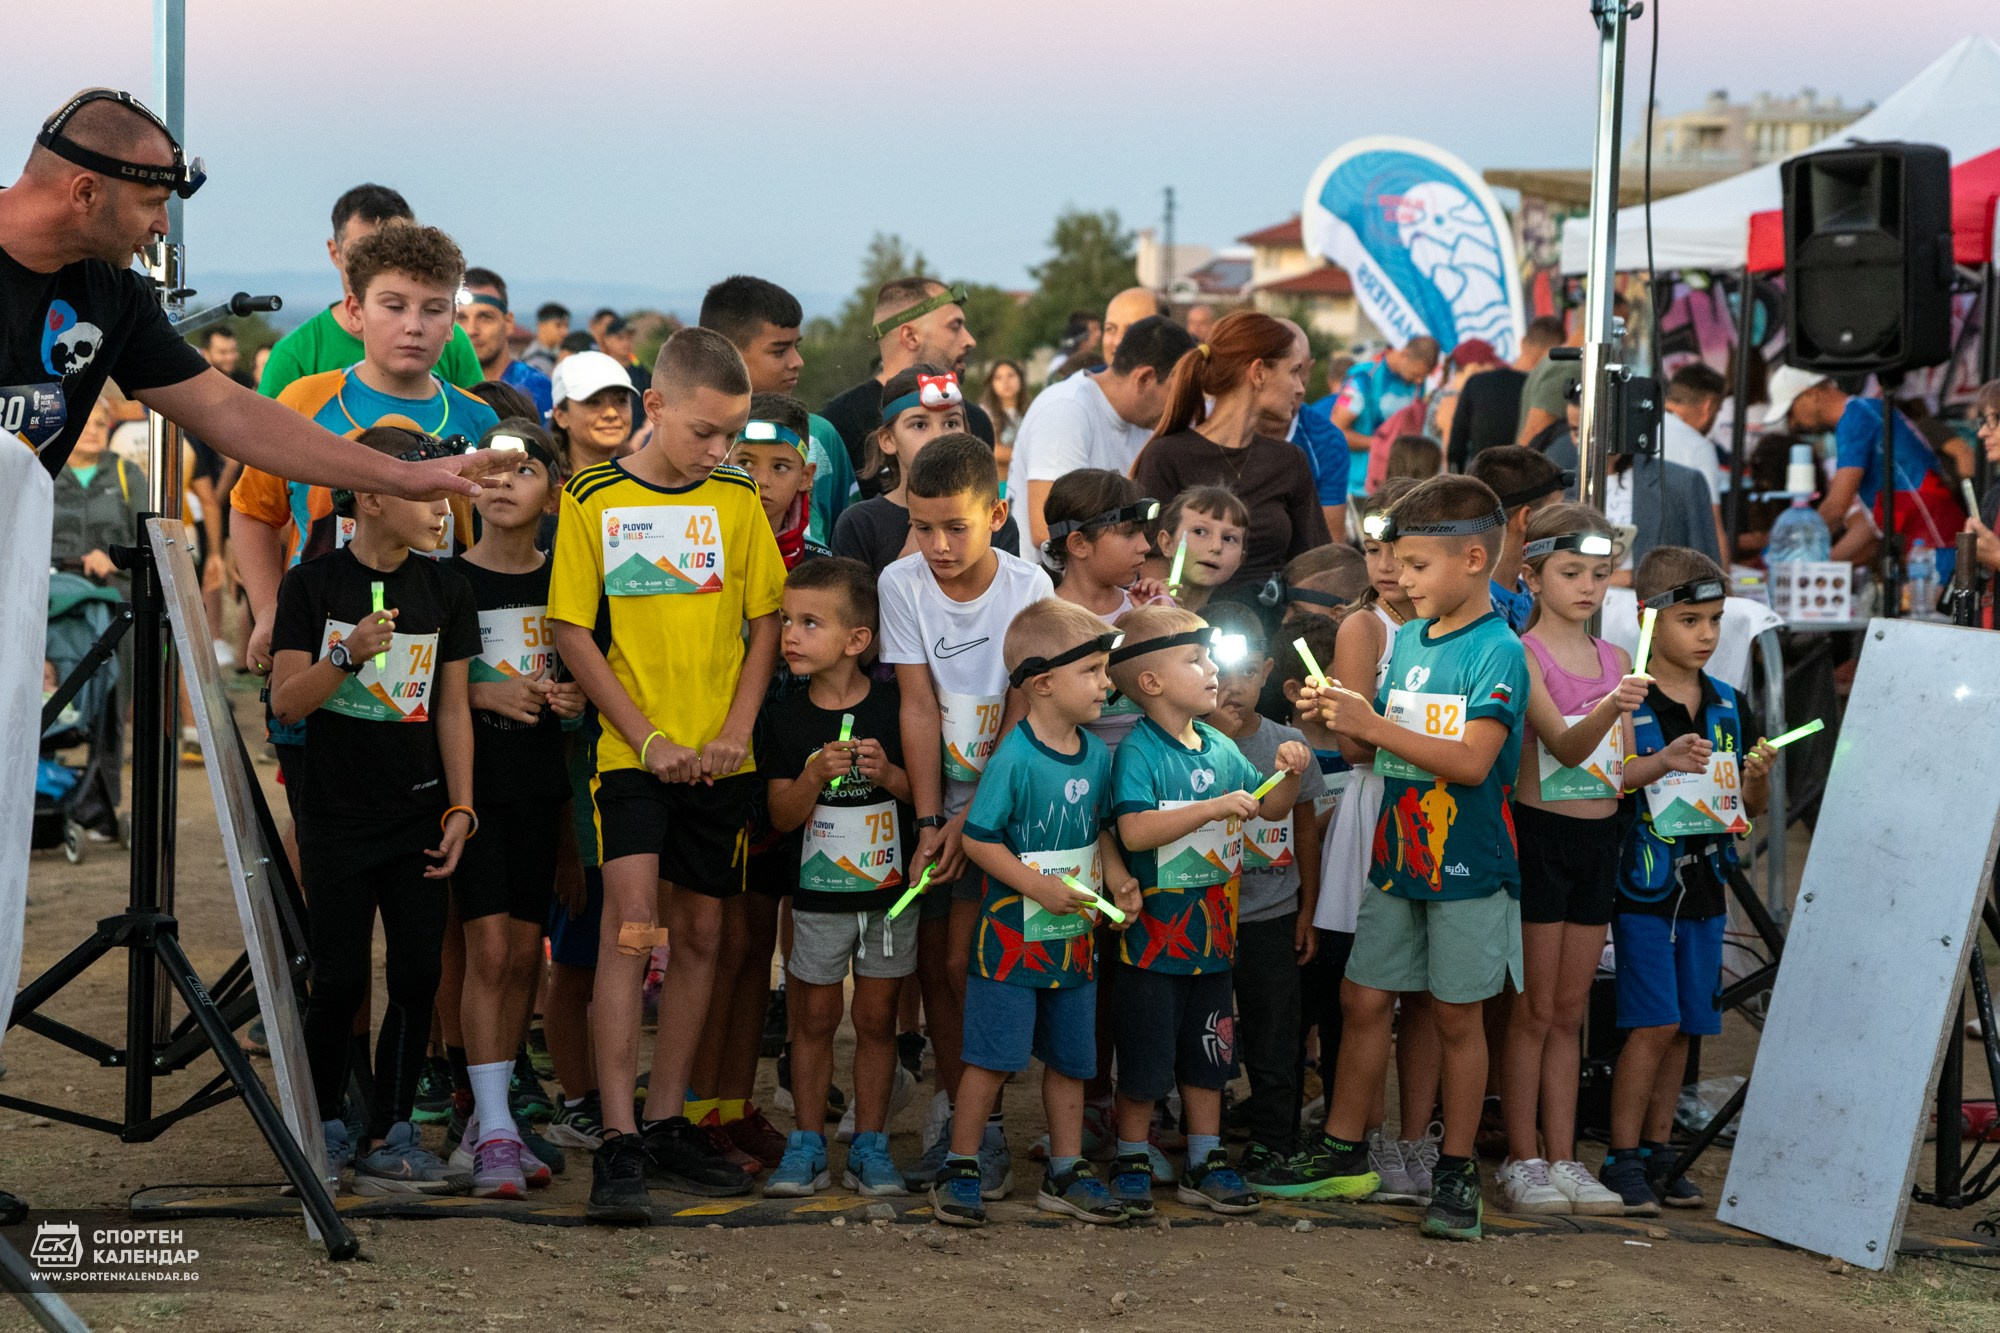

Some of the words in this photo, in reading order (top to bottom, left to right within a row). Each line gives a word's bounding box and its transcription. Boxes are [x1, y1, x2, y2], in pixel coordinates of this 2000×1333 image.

[623, 523, 653, 531] PLOVDIV
[623, 532, 644, 540] HILLS
[685, 515, 717, 546] 42
[679, 552, 716, 569] KIDS
[522, 616, 554, 648] 56
[409, 643, 433, 676] 74
[519, 652, 553, 671] KIDS
[391, 681, 426, 699] KIDS
[976, 703, 1001, 736] 78
[1425, 703, 1459, 736] 82
[964, 739, 995, 758] KIDS
[1606, 759, 1623, 776] KIDS
[1713, 760, 1737, 790] 48
[1712, 795, 1738, 811] KIDS
[813, 820, 835, 830] PLOVDIV
[865, 810, 895, 845] 79
[1256, 827, 1288, 845] KIDS
[859, 847, 895, 868] KIDS
[1221, 838, 1242, 860] KIDS
[960, 1168, 980, 1177] FILA
[1132, 1162, 1151, 1171] FILA
[1207, 1161, 1225, 1171] FILA
